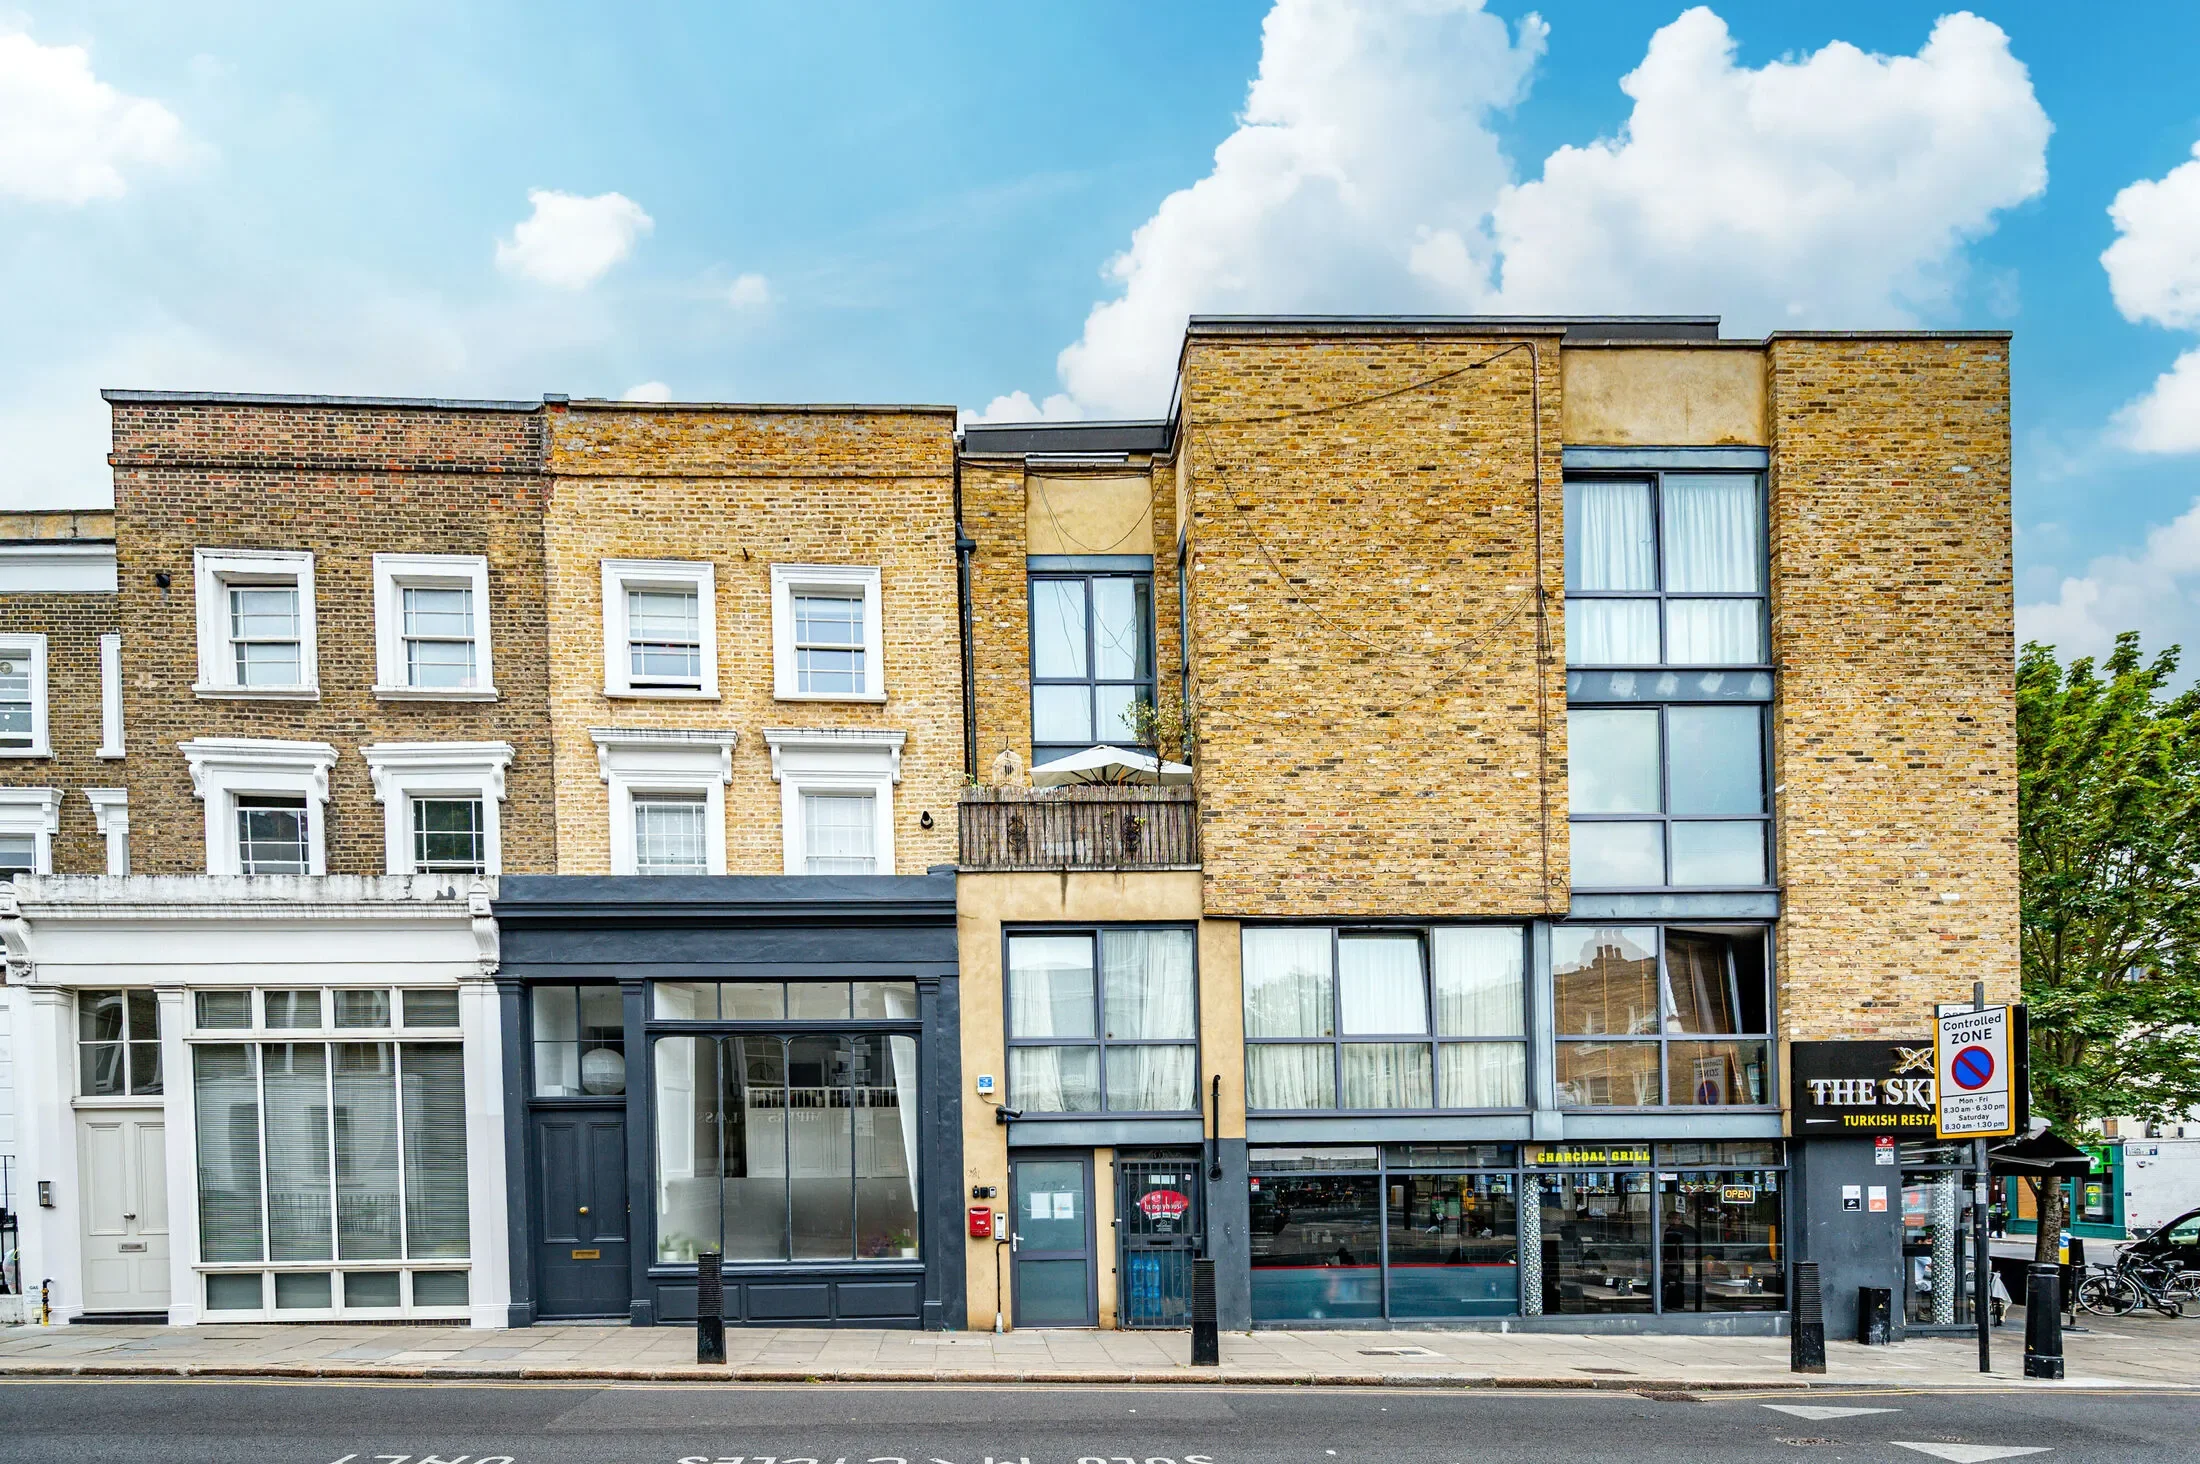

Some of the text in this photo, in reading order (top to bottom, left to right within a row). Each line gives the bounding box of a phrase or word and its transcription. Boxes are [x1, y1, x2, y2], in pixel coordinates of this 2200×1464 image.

[1943, 1013, 2001, 1031] Controlled
[1951, 1028, 1992, 1044] ZONE
[1809, 1079, 1877, 1105] THE
[1843, 1115, 1897, 1126] TURKISH
[1537, 1151, 1650, 1162] CHARCOAL GRILL
[1725, 1190, 1751, 1199] OPEN
